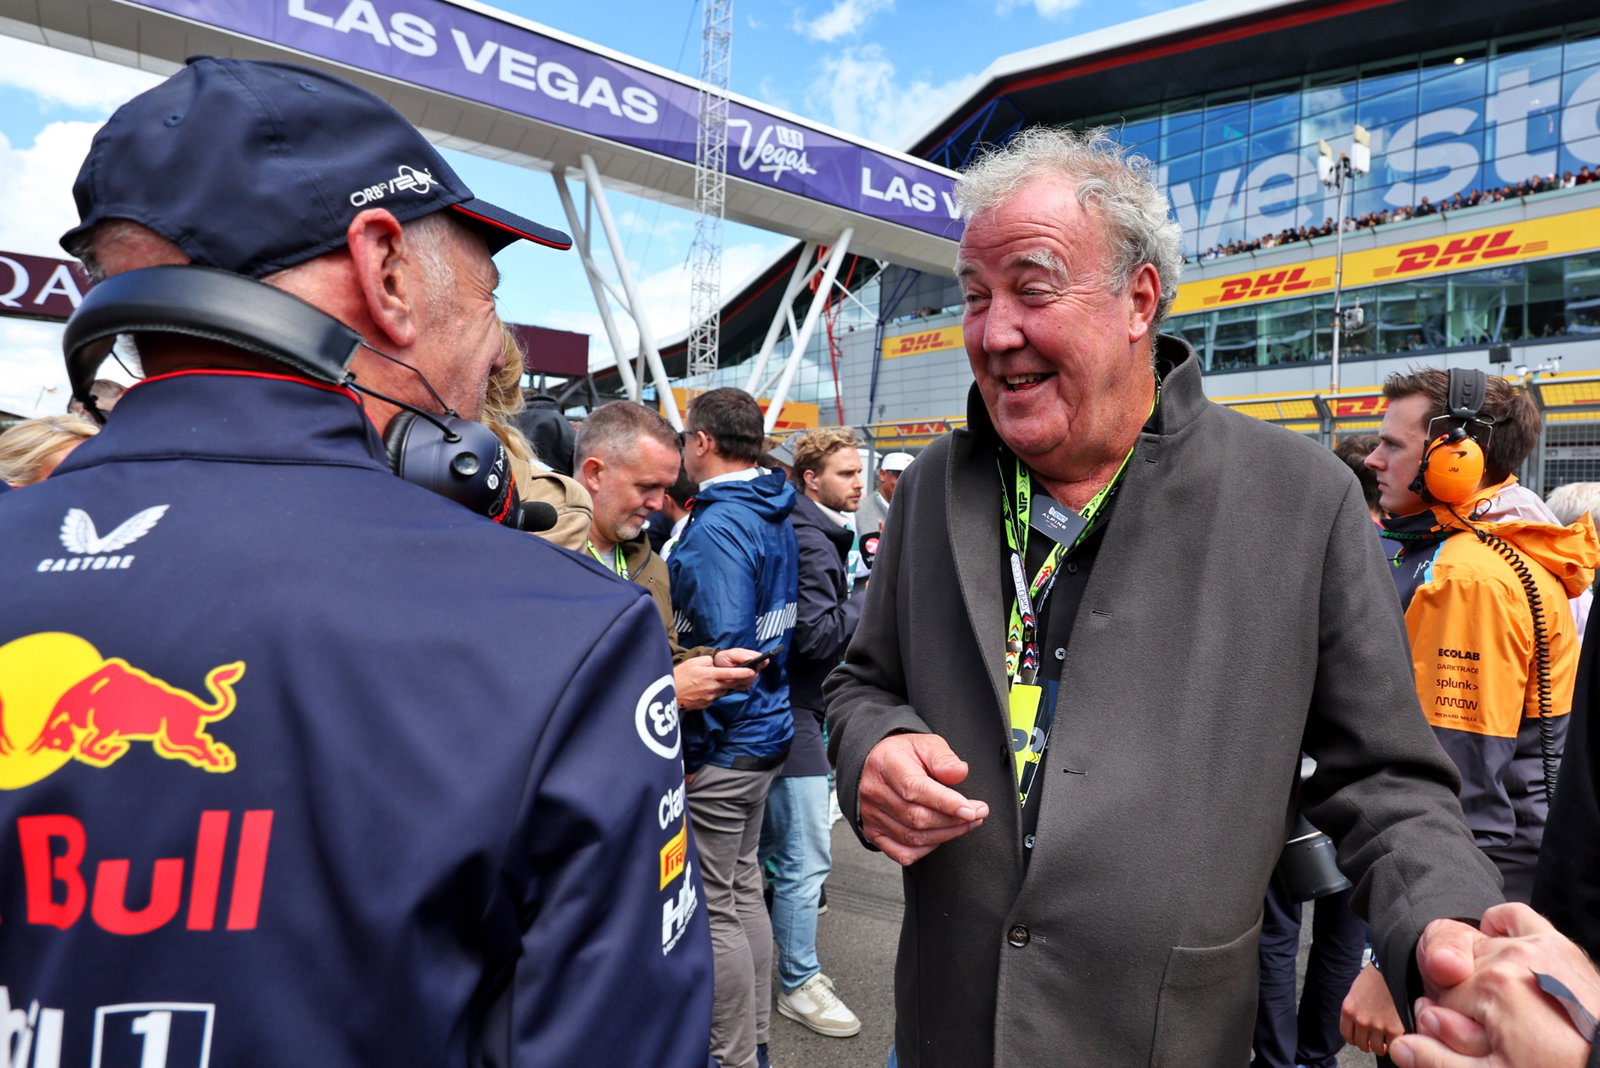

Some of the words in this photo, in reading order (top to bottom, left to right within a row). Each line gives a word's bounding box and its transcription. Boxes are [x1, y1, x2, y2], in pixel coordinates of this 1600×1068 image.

[288, 0, 438, 58] LAS
[450, 28, 660, 125] VEGAS
[726, 118, 818, 183] Vegas
[861, 166, 937, 213] LAS
[1395, 230, 1522, 274] DHL
[0, 256, 83, 309] QA
[1219, 267, 1312, 302] DHL
[899, 331, 944, 353] DHL
[1018, 491, 1028, 515] VIP
[1041, 512, 1067, 530] ALPINE
[36, 555, 136, 573] CASTORE
[1436, 663, 1480, 675] DARKTRACE
[1438, 648, 1480, 661] ECOLAB
[648, 696, 679, 737] Ess
[658, 779, 686, 830] Clar
[16, 809, 275, 936] Bull
[131, 1009, 173, 1068] 1
